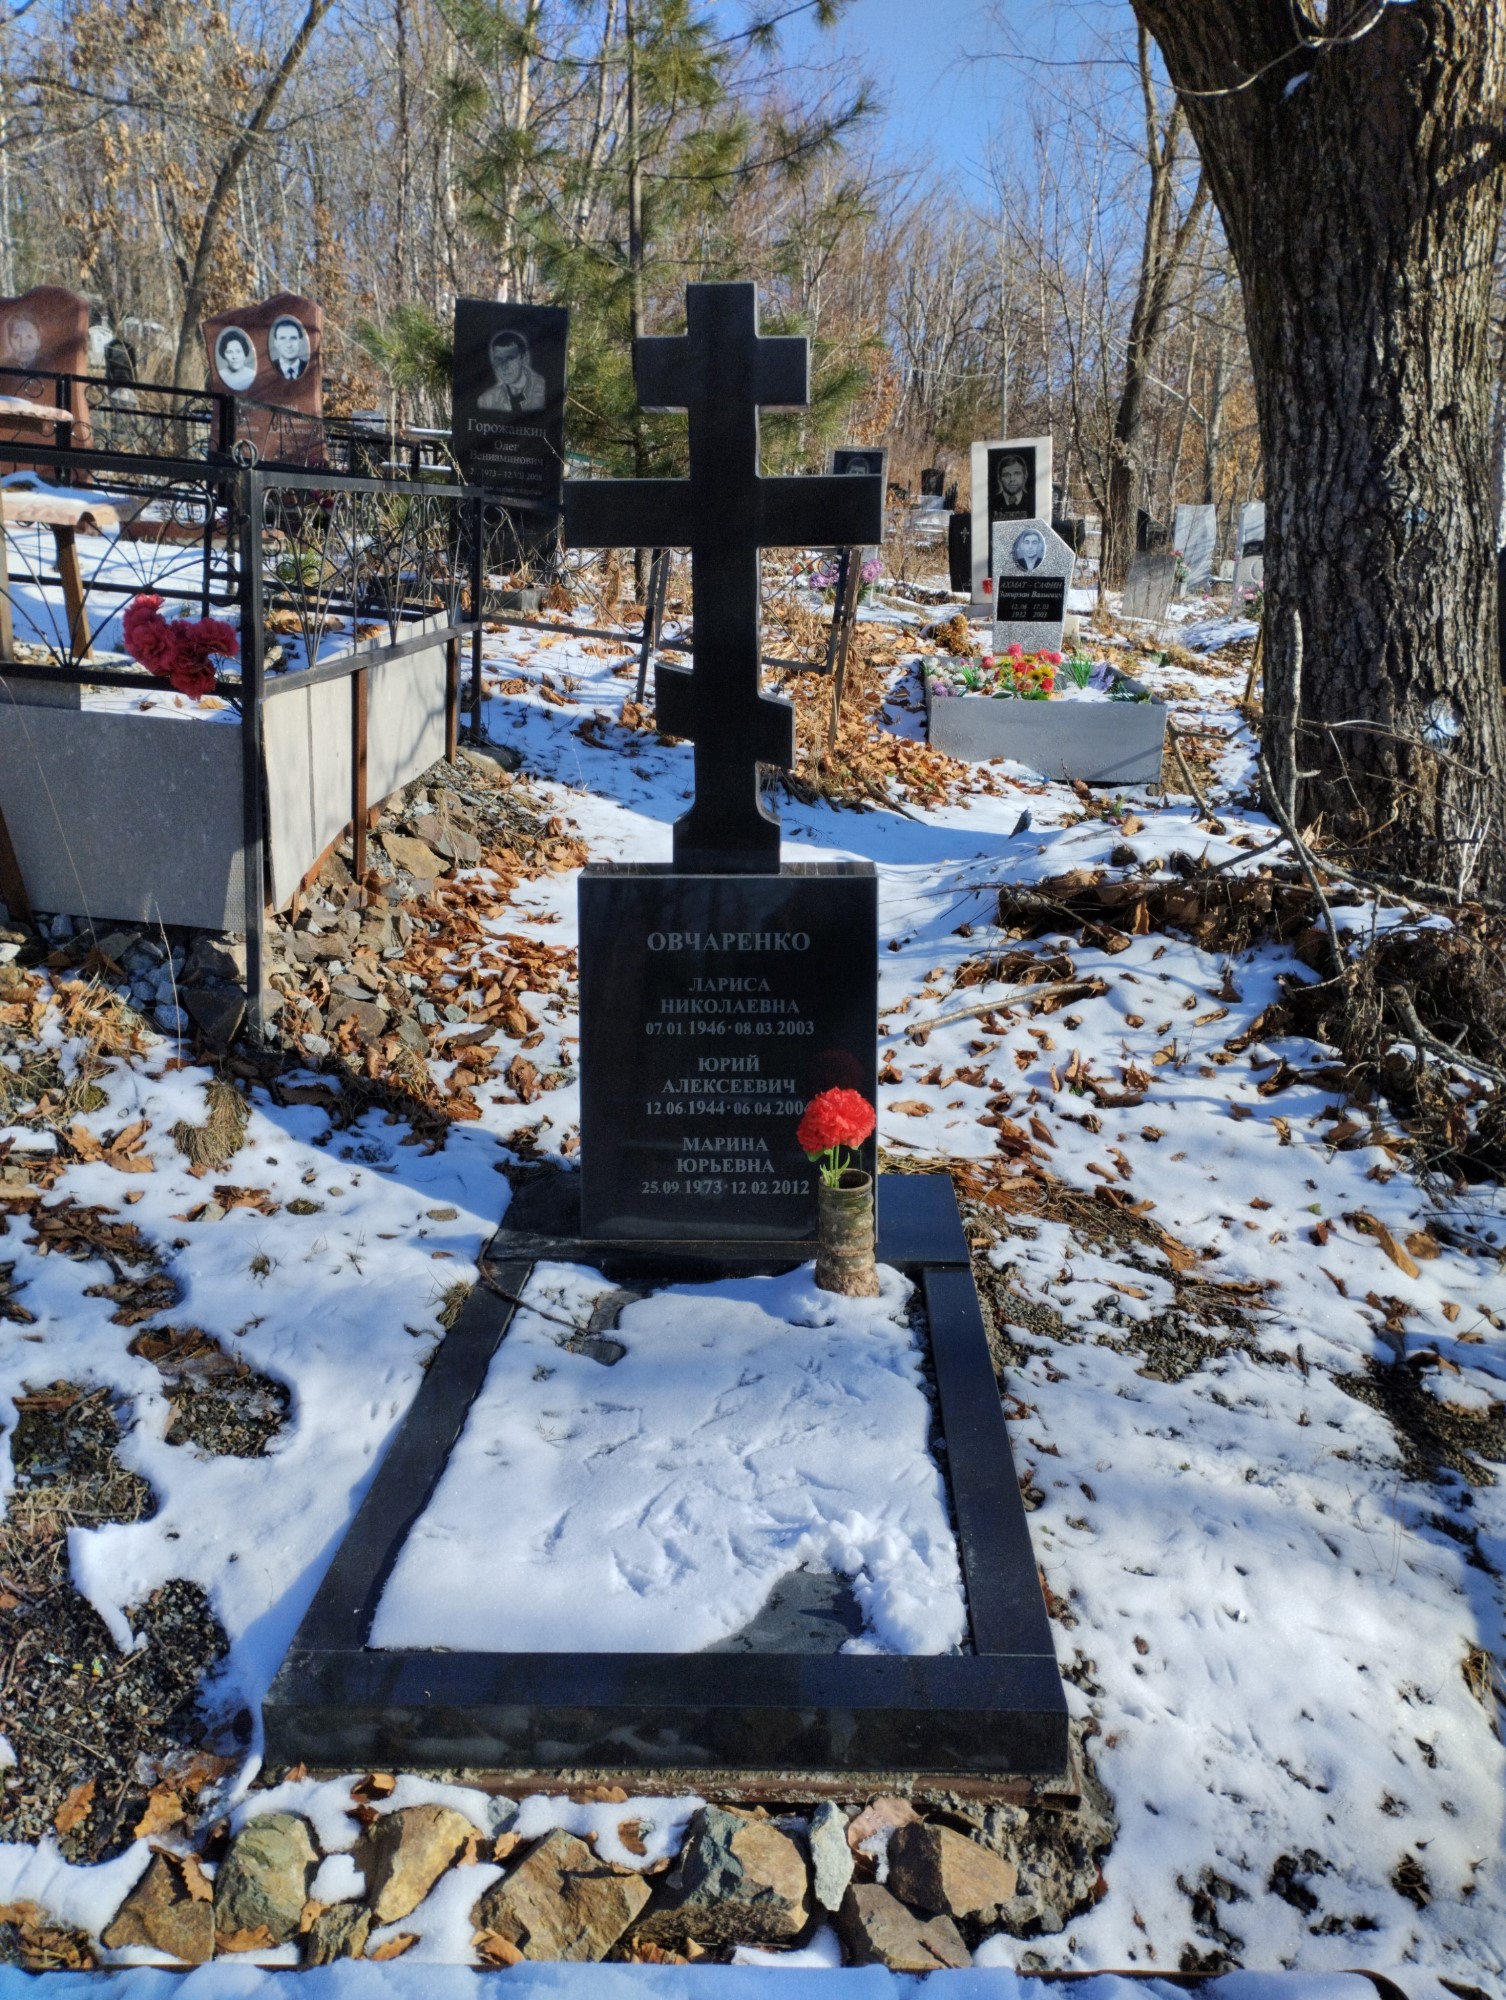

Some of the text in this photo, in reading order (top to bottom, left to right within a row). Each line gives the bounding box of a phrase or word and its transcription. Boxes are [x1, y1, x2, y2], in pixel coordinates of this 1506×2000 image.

[467, 418, 547, 437] Горожанкин
[494, 440, 519, 451] Олег
[646, 931, 811, 952] ОВЧАРЕНКО
[689, 977, 771, 992] ЛАРИСА
[660, 998, 800, 1014] НИКОЛАЕВНА
[697, 1054, 760, 1072] ЮРИЙ
[661, 1078, 796, 1094] АЛЕКСЕЕВИЧ
[682, 1137, 769, 1152] МАРИНА
[676, 1158, 775, 1173] ЮРЬЕВНА
